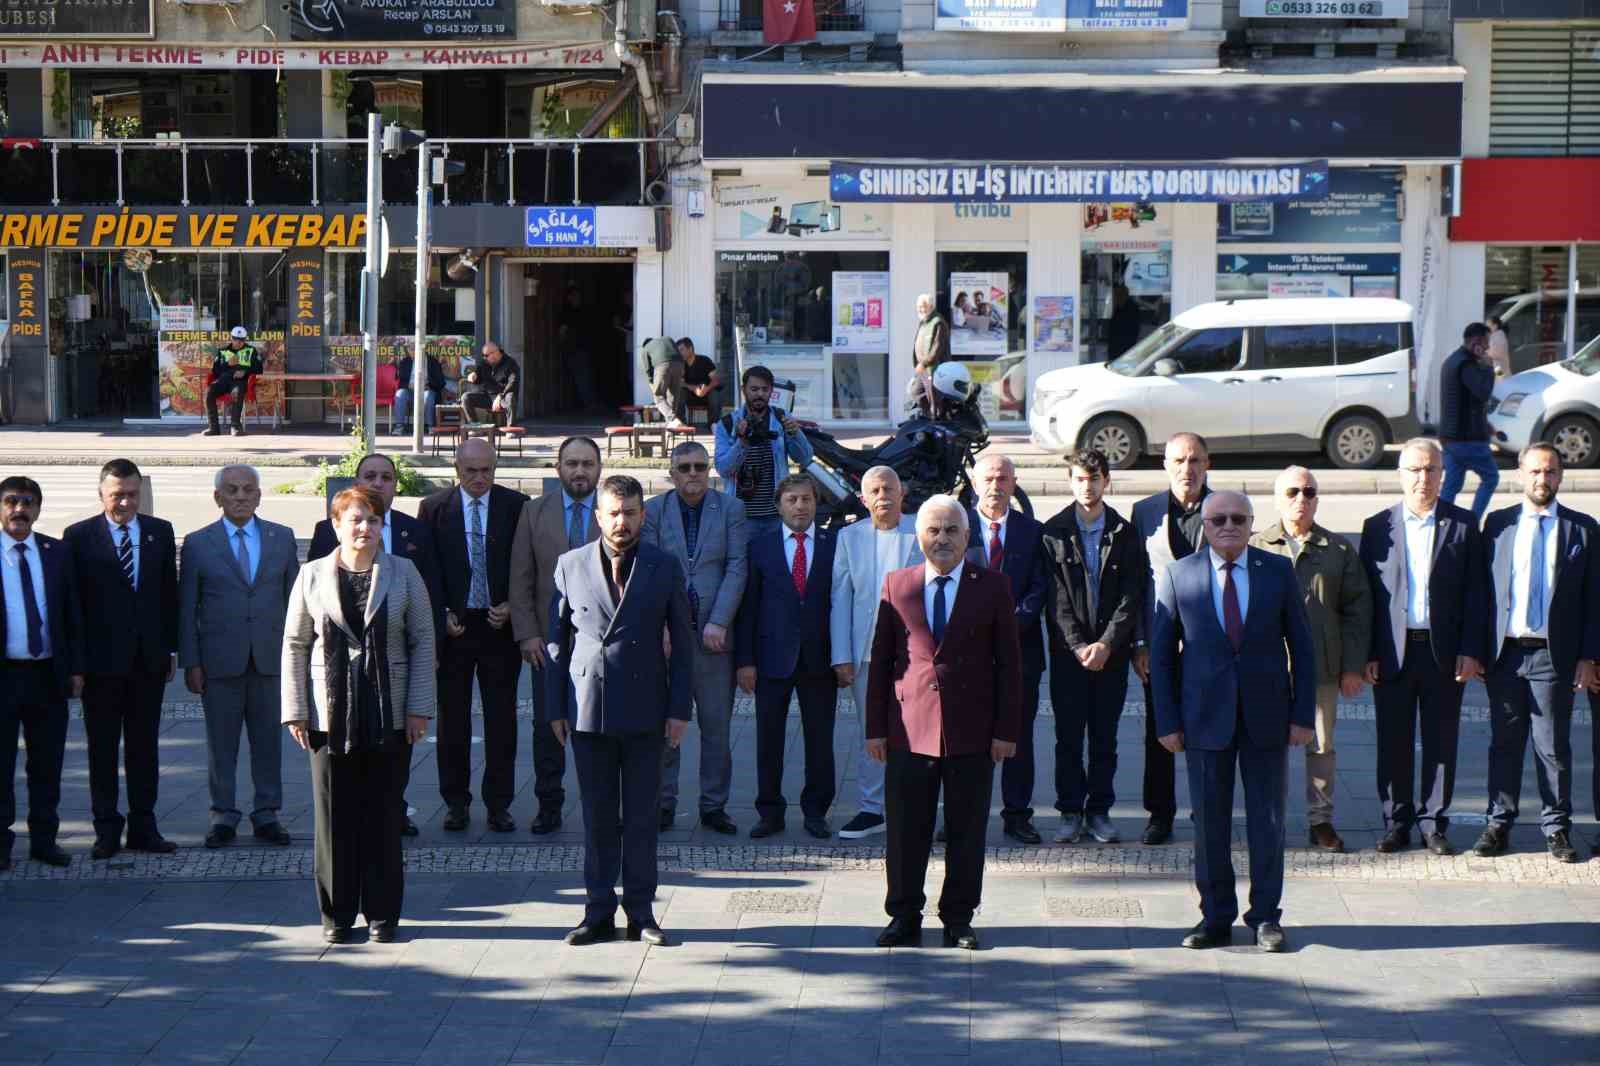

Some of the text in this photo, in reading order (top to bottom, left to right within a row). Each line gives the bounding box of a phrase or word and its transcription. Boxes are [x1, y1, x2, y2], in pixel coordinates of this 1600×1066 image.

[384, 9, 471, 21] Recep ARSLAN
[1282, 3, 1374, 14] 0533 326 03 62
[42, 45, 104, 63] ANIT
[112, 47, 203, 63] TERME
[318, 50, 389, 64] KEBAP
[423, 49, 528, 64] KAHVALTI
[562, 49, 605, 63] 7/24
[858, 164, 1300, 200] SINIRSIZ EV-İŞ İNTERNET BAŞVURU NOKTASI
[954, 199, 1011, 218] tivibu
[0, 207, 367, 247] RME PİDE VE KEBAP
[528, 208, 593, 237] SAĞLAM
[545, 230, 577, 244] İŞ HANI
[17, 272, 36, 317] BAFRA
[296, 272, 314, 318] BAFRA
[12, 321, 42, 336] PİDE
[167, 331, 208, 341] TERME
[291, 322, 321, 336] PİDE
[330, 346, 363, 356] TERM
